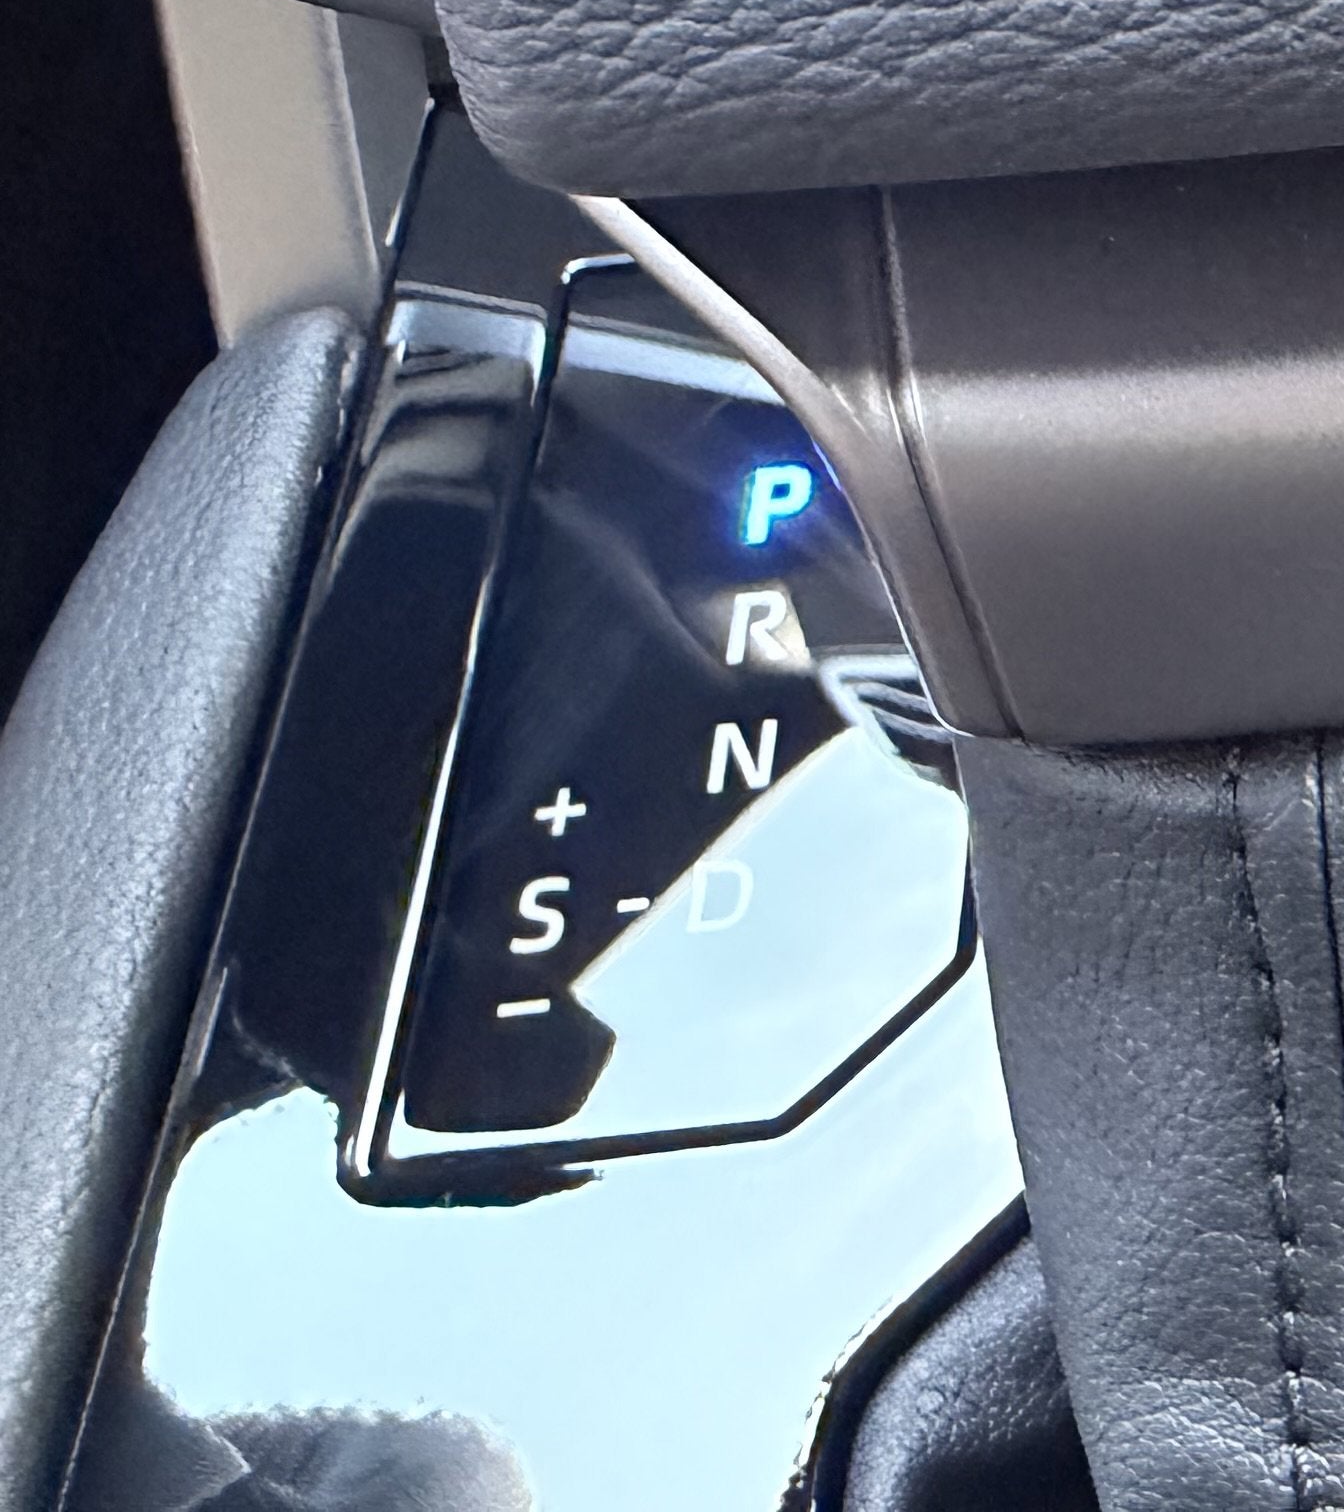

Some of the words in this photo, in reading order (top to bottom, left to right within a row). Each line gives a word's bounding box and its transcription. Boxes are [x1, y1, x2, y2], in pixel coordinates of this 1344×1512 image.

[743, 462, 813, 546] P
[725, 590, 789, 666] R
[707, 718, 778, 794] N
[509, 876, 570, 954] S
[687, 860, 755, 933] D
